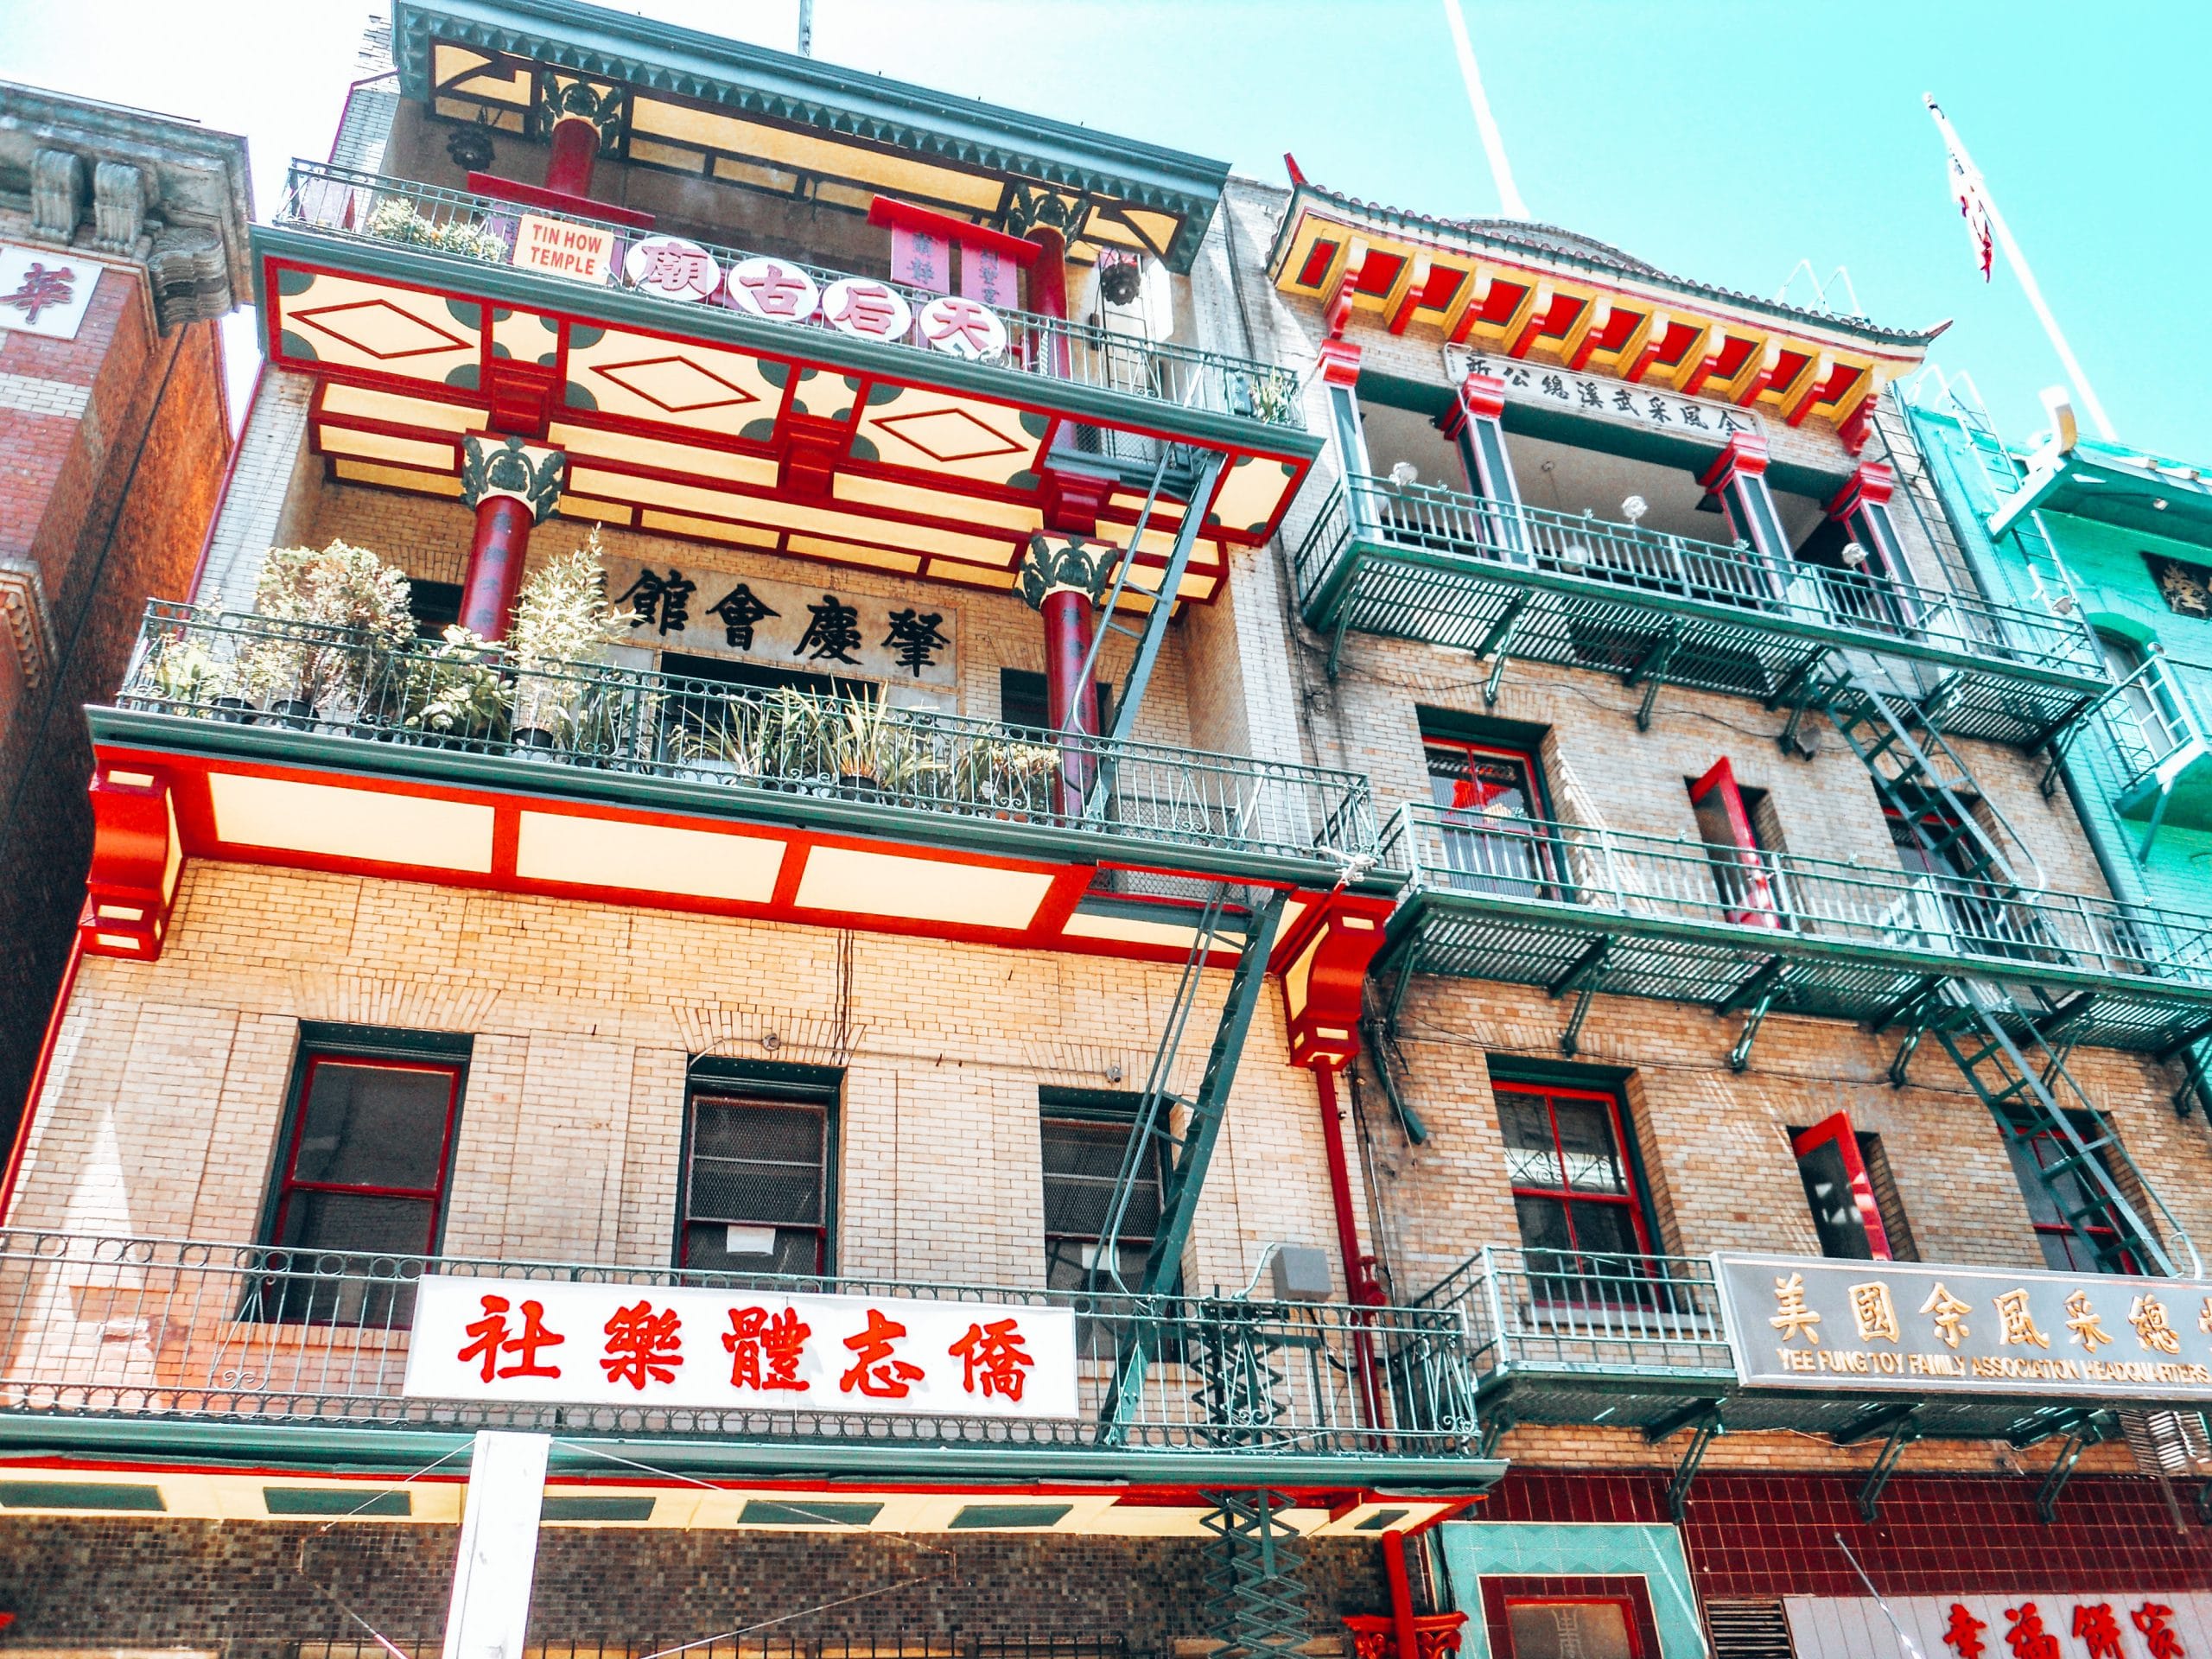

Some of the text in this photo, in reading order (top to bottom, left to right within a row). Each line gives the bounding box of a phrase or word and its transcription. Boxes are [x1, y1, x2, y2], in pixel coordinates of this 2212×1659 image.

[533, 224, 560, 245] TIN
[564, 231, 601, 254] HOW
[531, 246, 595, 276] TEMPLE
[1769, 1271, 2212, 1354] 美國余風采總
[1776, 1348, 2212, 1384] YEE FUNG TOY FAMILY ASSOCIATION HEADQUARTERS
